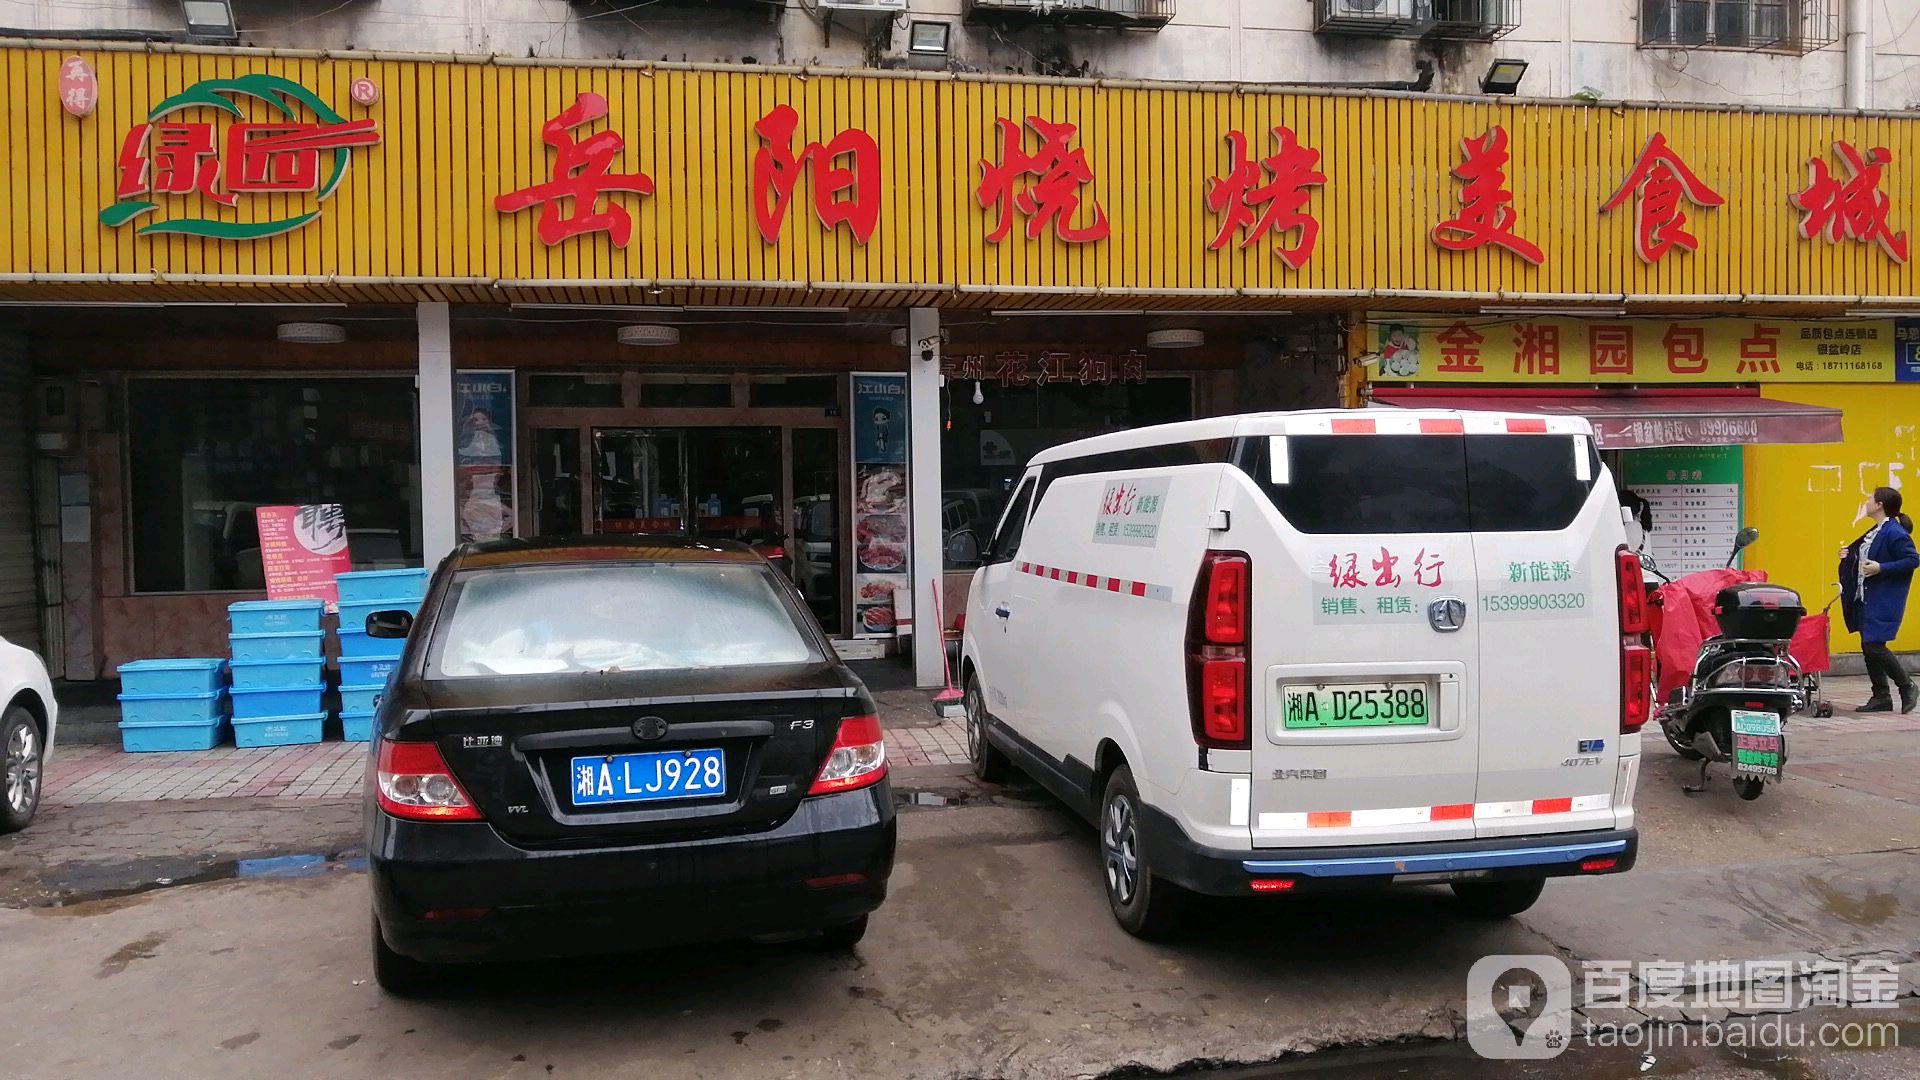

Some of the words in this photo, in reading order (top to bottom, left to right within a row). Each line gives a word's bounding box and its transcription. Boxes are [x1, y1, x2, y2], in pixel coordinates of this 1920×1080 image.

[494, 92, 1908, 270] 岳阳烧烤美食城
[1800, 327, 1878, 340] 品质包点连锁店
[1436, 321, 1781, 374] 金湘园包点
[1817, 343, 1862, 356] 银盆岭店
[1327, 546, 1445, 589] 绿出行
[1507, 560, 1573, 583] 新能源
[1482, 592, 1586, 612] 15399903320
[790, 719, 815, 730] F3
[463, 735, 502, 748] 比亚迪
